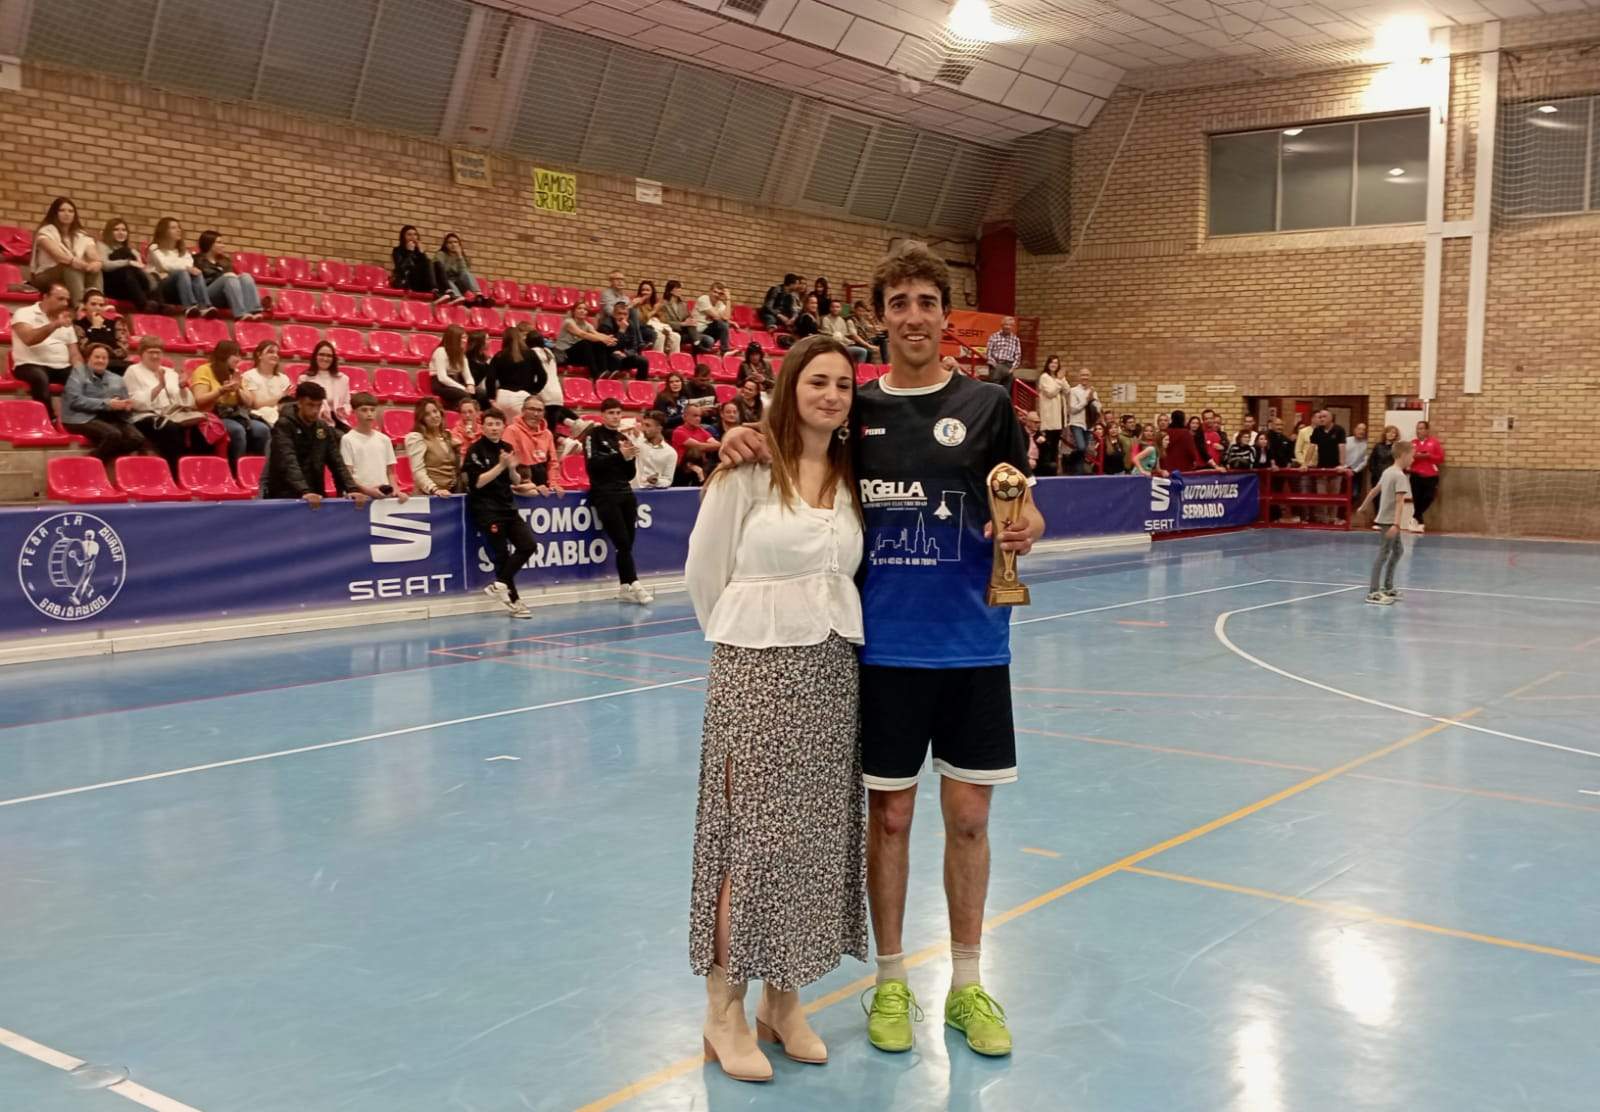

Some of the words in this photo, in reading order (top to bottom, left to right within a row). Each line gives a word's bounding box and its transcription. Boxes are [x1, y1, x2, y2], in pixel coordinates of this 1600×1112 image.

[536, 172, 574, 197] VAMOS
[958, 328, 985, 337] SEAT
[1181, 480, 1239, 500] AUTOMÓVILES
[1182, 503, 1225, 519] SERRABLO
[63, 515, 83, 526] LA
[1144, 518, 1175, 531] SEAT
[478, 538, 608, 573] SRABLO
[348, 573, 453, 601] SEAT
